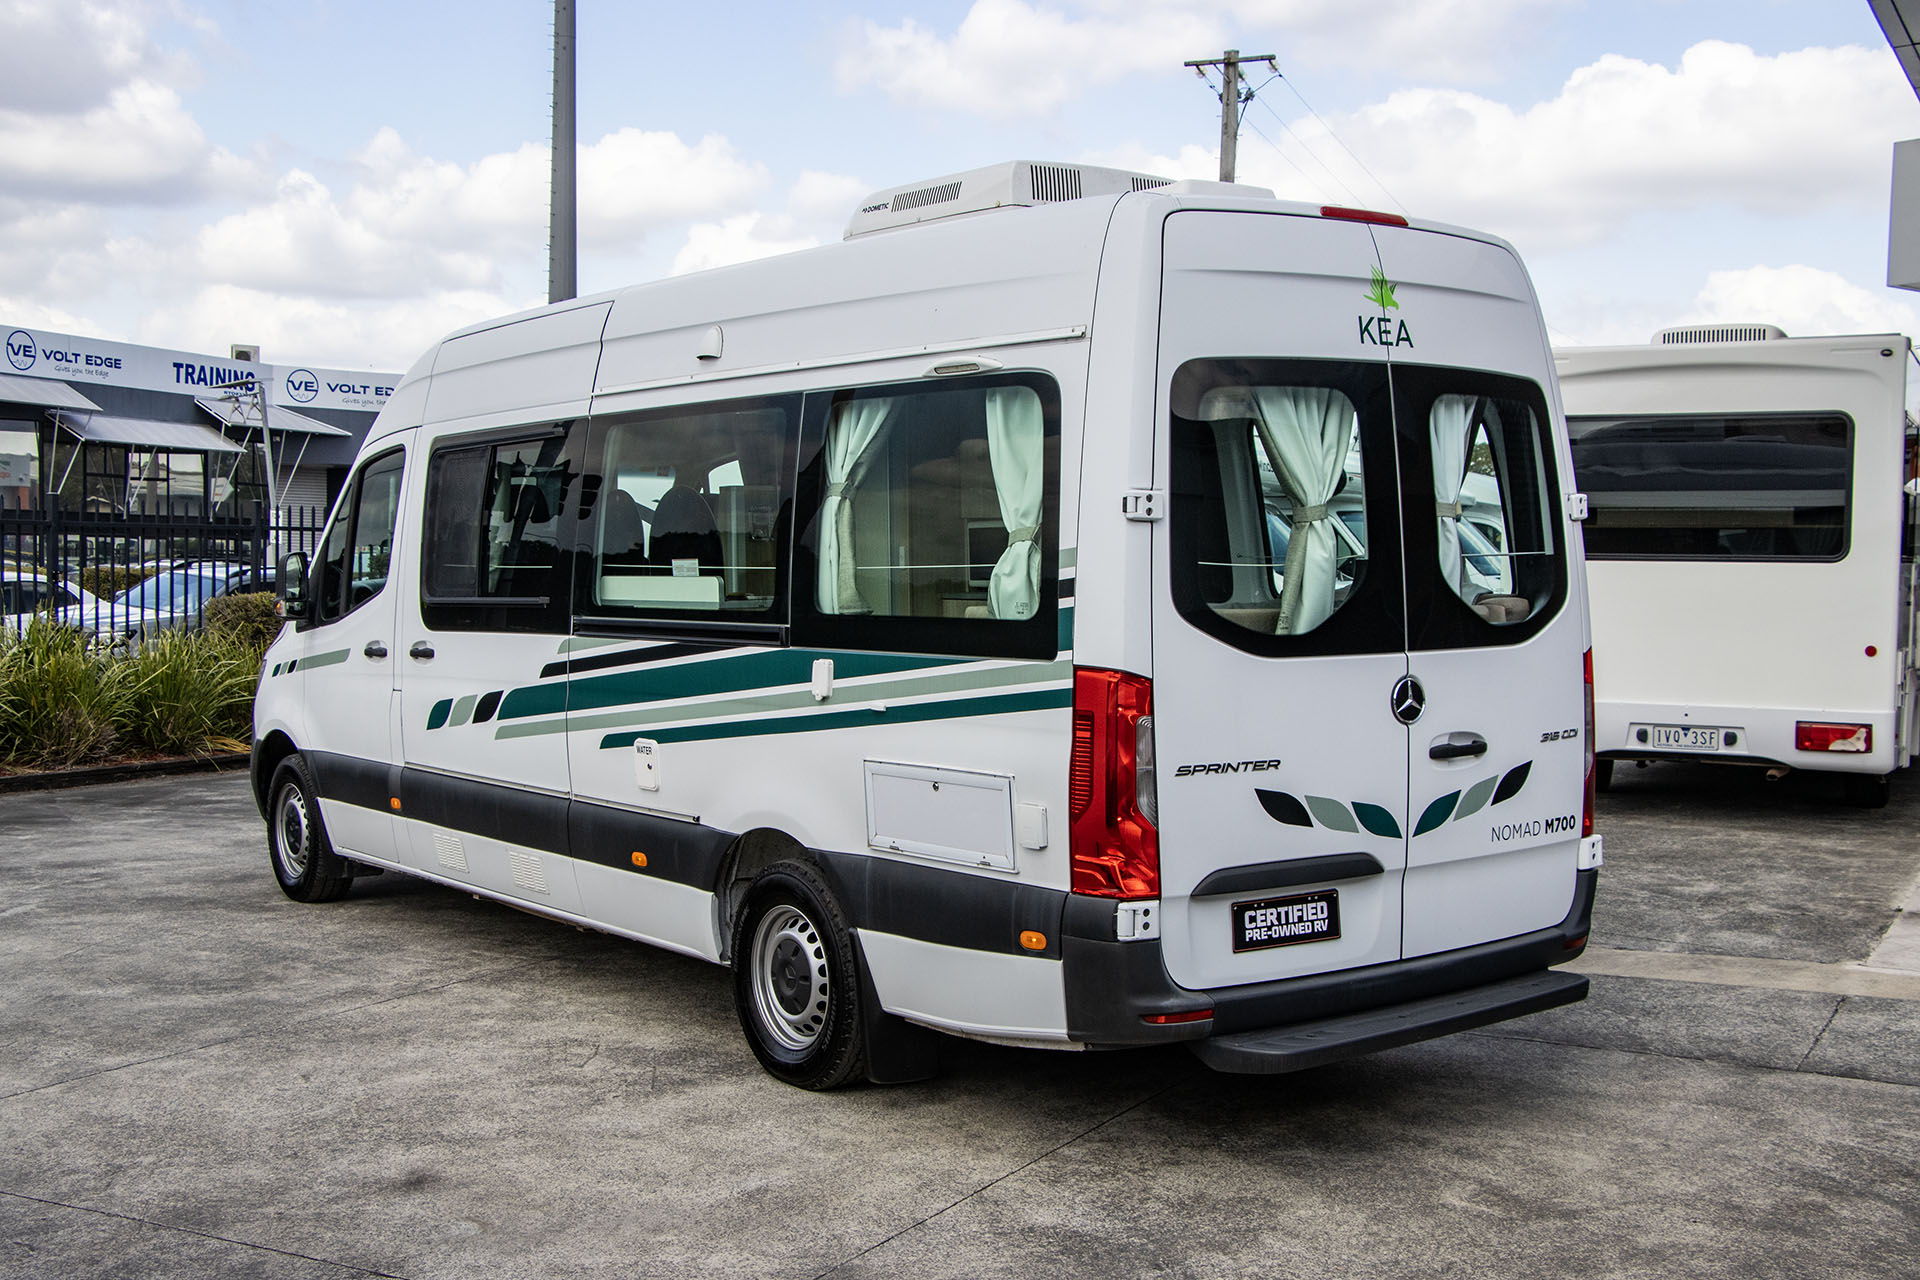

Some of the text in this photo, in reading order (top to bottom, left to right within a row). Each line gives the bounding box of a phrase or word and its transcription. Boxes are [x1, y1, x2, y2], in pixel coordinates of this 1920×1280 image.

[1358, 315, 1414, 348] KEA
[8, 343, 35, 358] VE
[42, 349, 122, 369] VOLT EDGE
[54, 363, 70, 372] Gives
[71, 367, 83, 376] you
[95, 370, 109, 379] Edge
[172, 362, 255, 392] TRAINING
[288, 379, 318, 392] VE
[326, 382, 370, 395] VOLT
[342, 397, 360, 405] Gives
[361, 399, 374, 407] you
[1561, 728, 1578, 739] CDI
[1691, 731, 1716, 745] 3SF
[636, 745, 652, 756] WATER
[1175, 759, 1281, 777] SPRINTER
[1490, 814, 1577, 843] NOMAD M700
[1244, 901, 1328, 929] CERTIFIED
[1245, 918, 1329, 943] PRE-OWNED RV
